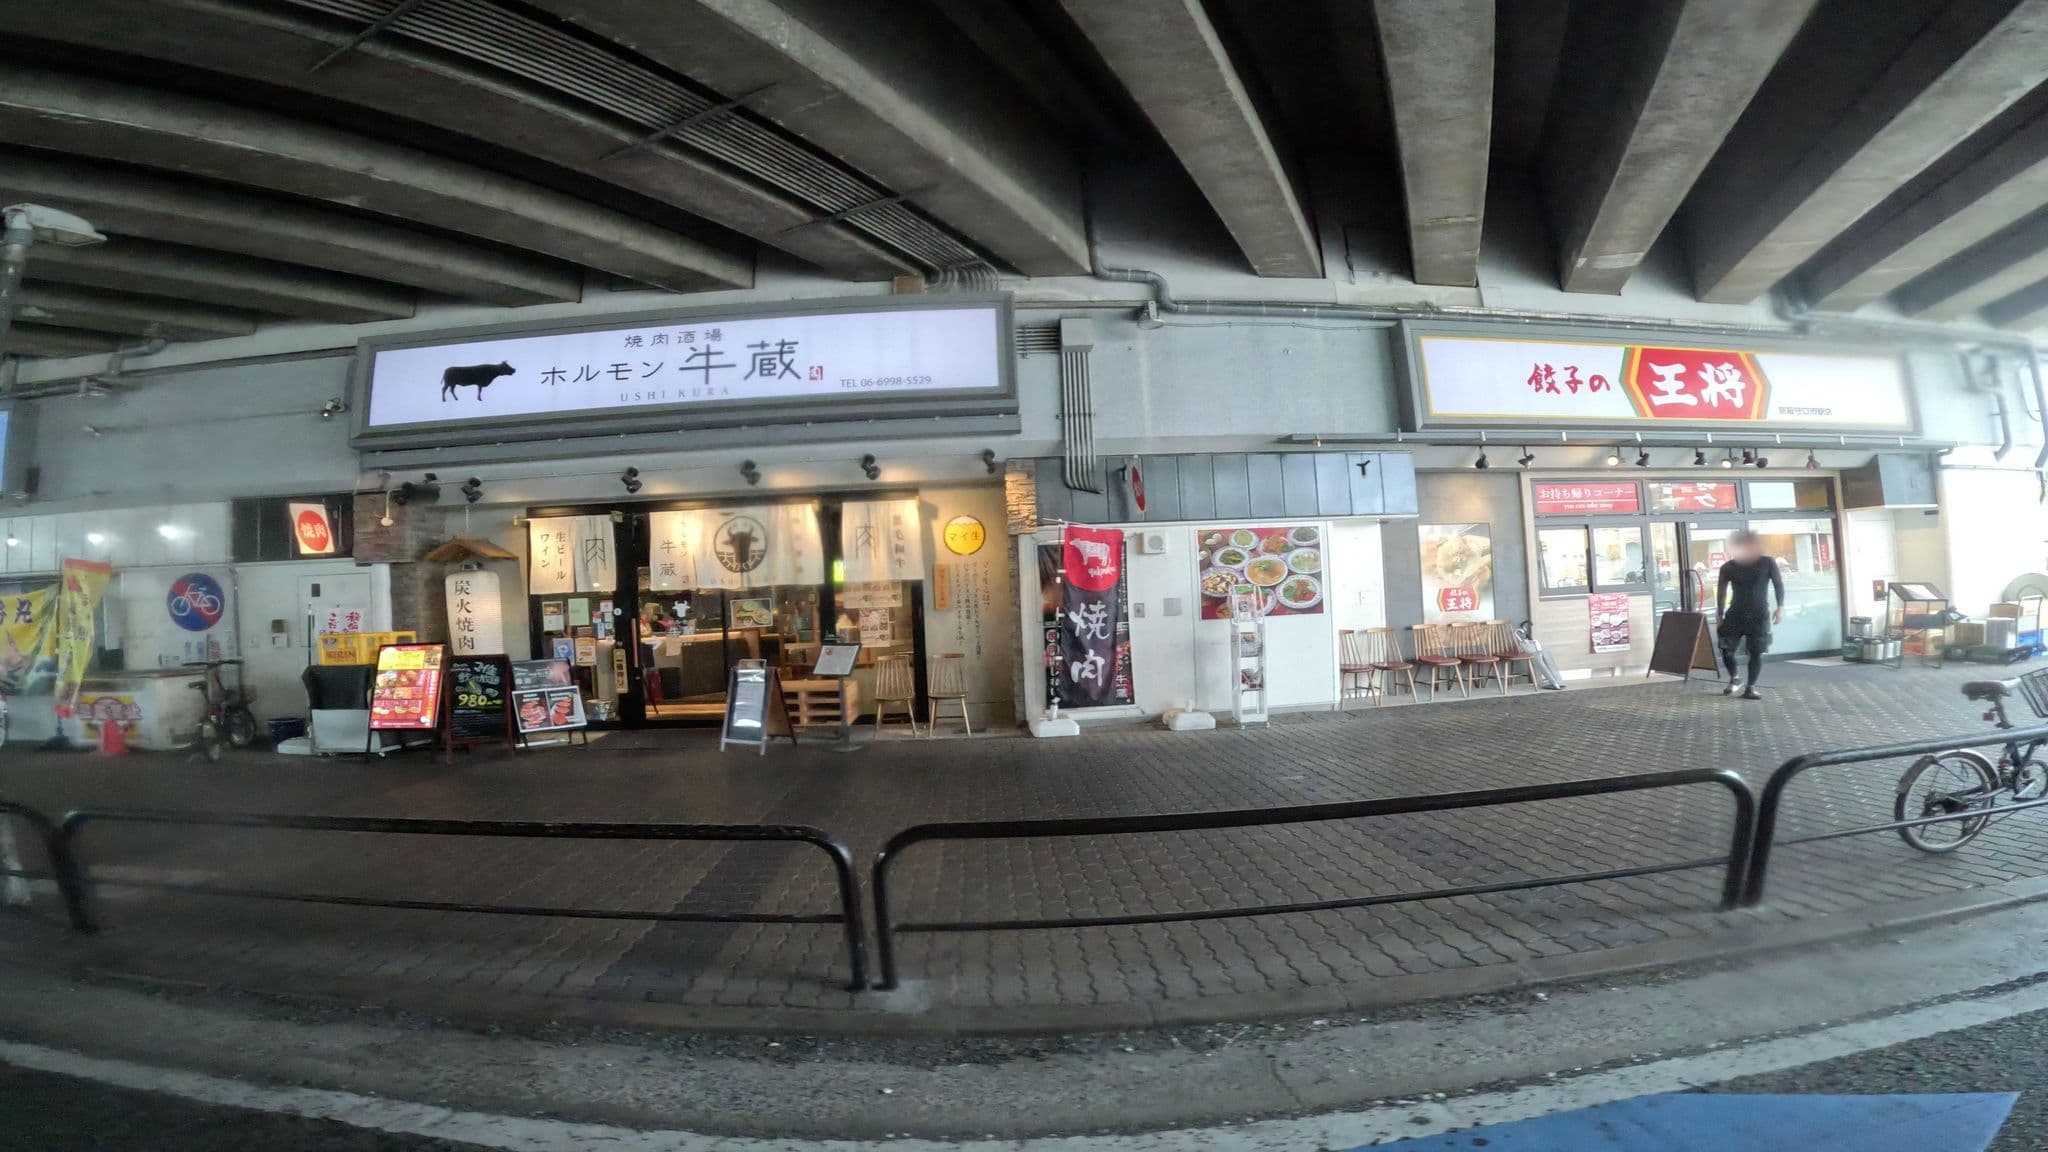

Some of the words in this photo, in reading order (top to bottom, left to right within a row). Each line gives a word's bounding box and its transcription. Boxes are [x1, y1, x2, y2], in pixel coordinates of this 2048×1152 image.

[624, 328, 723, 348] 焼肉酒場
[540, 361, 665, 386] ホルモン
[678, 338, 802, 385] 牛蔵
[1527, 362, 1611, 395] 餃子の
[620, 390, 666, 401] USHI
[678, 386, 730, 399] KURA
[840, 378, 858, 388] TEL
[861, 376, 932, 388] 06-6998-5529
[1648, 361, 1747, 409] 王将
[1539, 487, 1634, 500] お持ち帰りコーナー
[301, 522, 326, 539] 焼肉
[948, 531, 980, 542] マイ生
[540, 533, 550, 568] ワイン
[556, 532, 567, 580] 生ビール
[585, 538, 607, 572] 肉
[659, 540, 677, 577] 牛蔵
[454, 580, 475, 650] 炭火焼肉
[1446, 597, 1473, 610] 王将
[1068, 600, 1111, 688] 焼肉
[458, 694, 488, 708] 980
